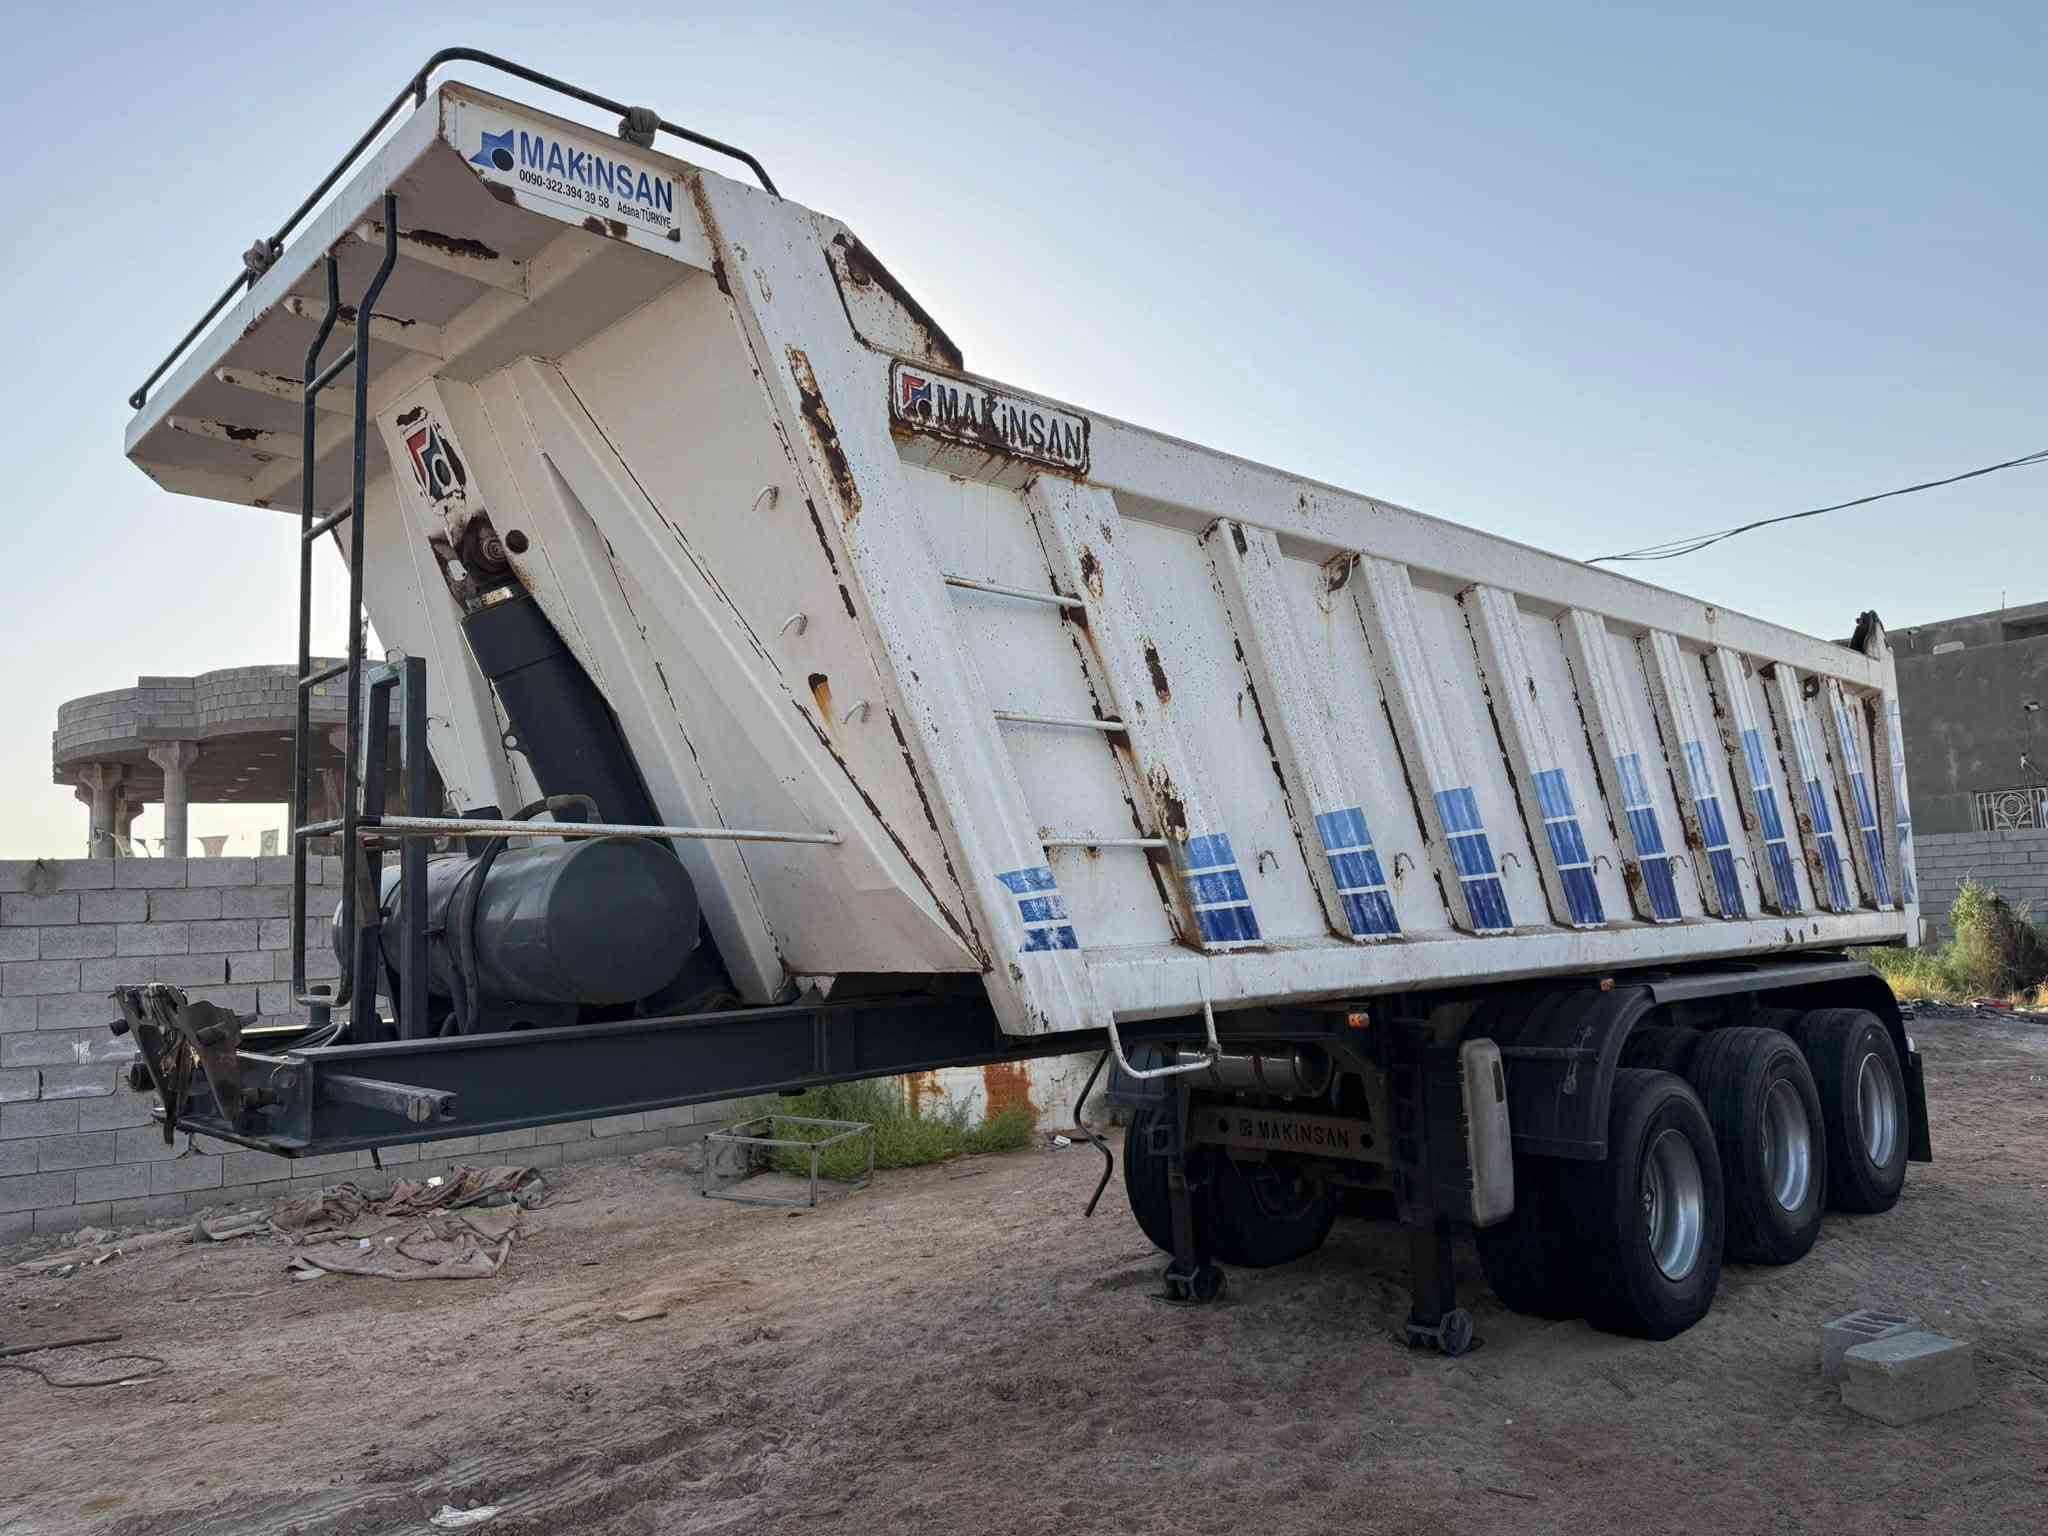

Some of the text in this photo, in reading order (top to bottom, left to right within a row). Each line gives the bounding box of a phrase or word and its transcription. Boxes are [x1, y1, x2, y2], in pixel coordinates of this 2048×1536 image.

[519, 168, 582, 201] 0090-322.394
[584, 190, 596, 204] 39
[598, 194, 610, 209] 58
